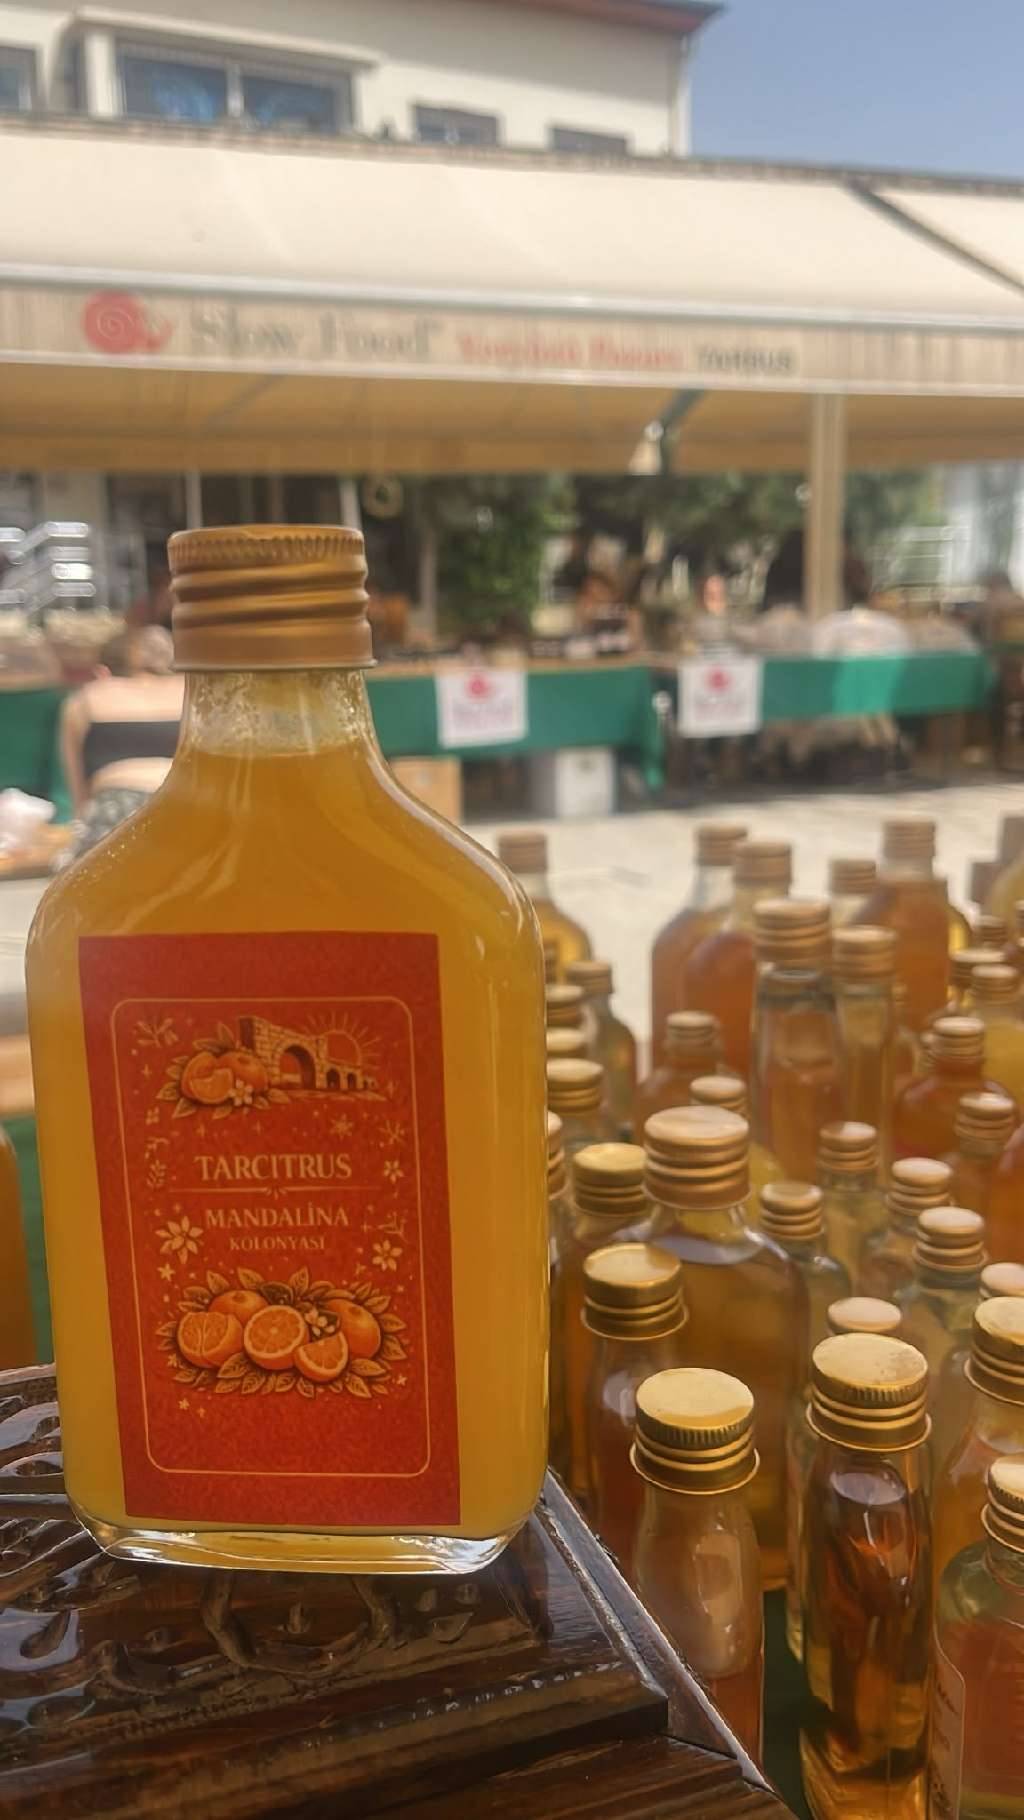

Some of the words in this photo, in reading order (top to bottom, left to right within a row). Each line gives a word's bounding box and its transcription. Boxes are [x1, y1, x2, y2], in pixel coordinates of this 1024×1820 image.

[194, 1153, 352, 1182] TARCITRUS
[205, 1202, 350, 1229] MANDALİNA
[228, 1235, 326, 1252] KOLONYASI
